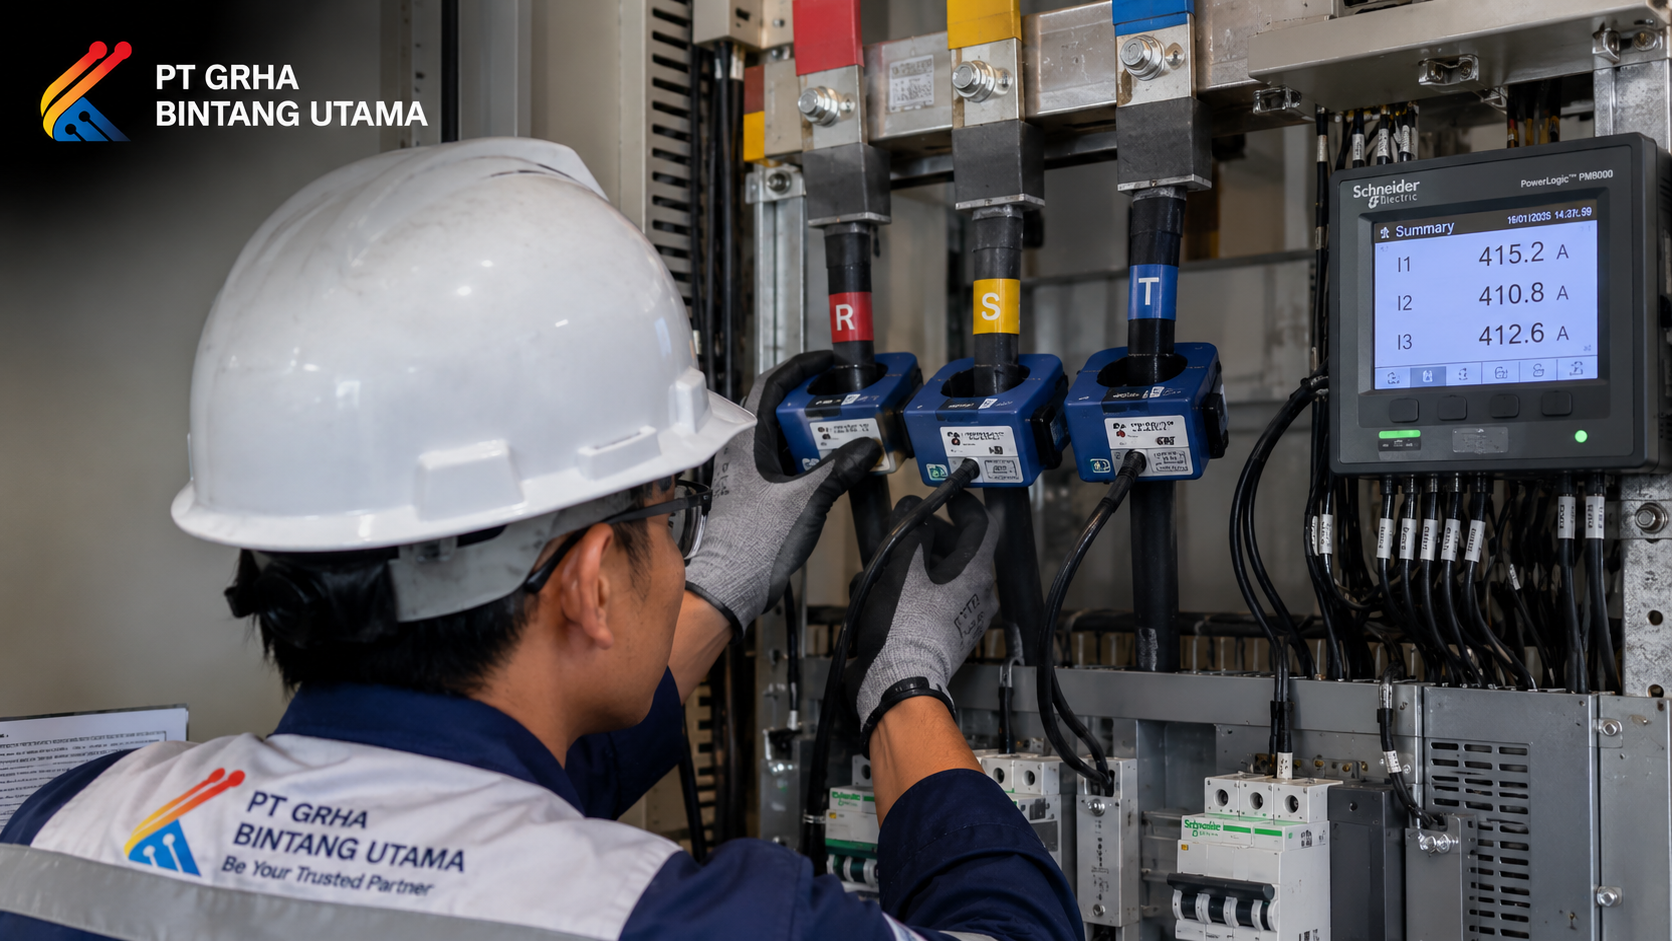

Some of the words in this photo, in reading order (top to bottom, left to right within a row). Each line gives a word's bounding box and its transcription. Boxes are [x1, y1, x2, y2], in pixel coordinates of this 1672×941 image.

[1353, 179, 1420, 198] Schneider
[1395, 222, 1455, 238] Summary
[1478, 241, 1545, 267] 415.2
[1556, 243, 1570, 260] A
[1138, 276, 1161, 306] T
[1478, 282, 1545, 306] 410.8
[1556, 285, 1570, 301] A
[835, 304, 855, 331] R
[981, 292, 1001, 321] S
[1478, 322, 1545, 346] 412.6
[1556, 325, 1570, 342] A
[246, 790, 288, 818] PT
[291, 802, 369, 829] GRHA
[232, 822, 360, 861] BINTANG
[365, 840, 465, 873] UTAMA
[221, 855, 247, 875] Be
[252, 861, 293, 881] Your
[296, 865, 366, 891] Trusted
[366, 875, 434, 897] Partner
